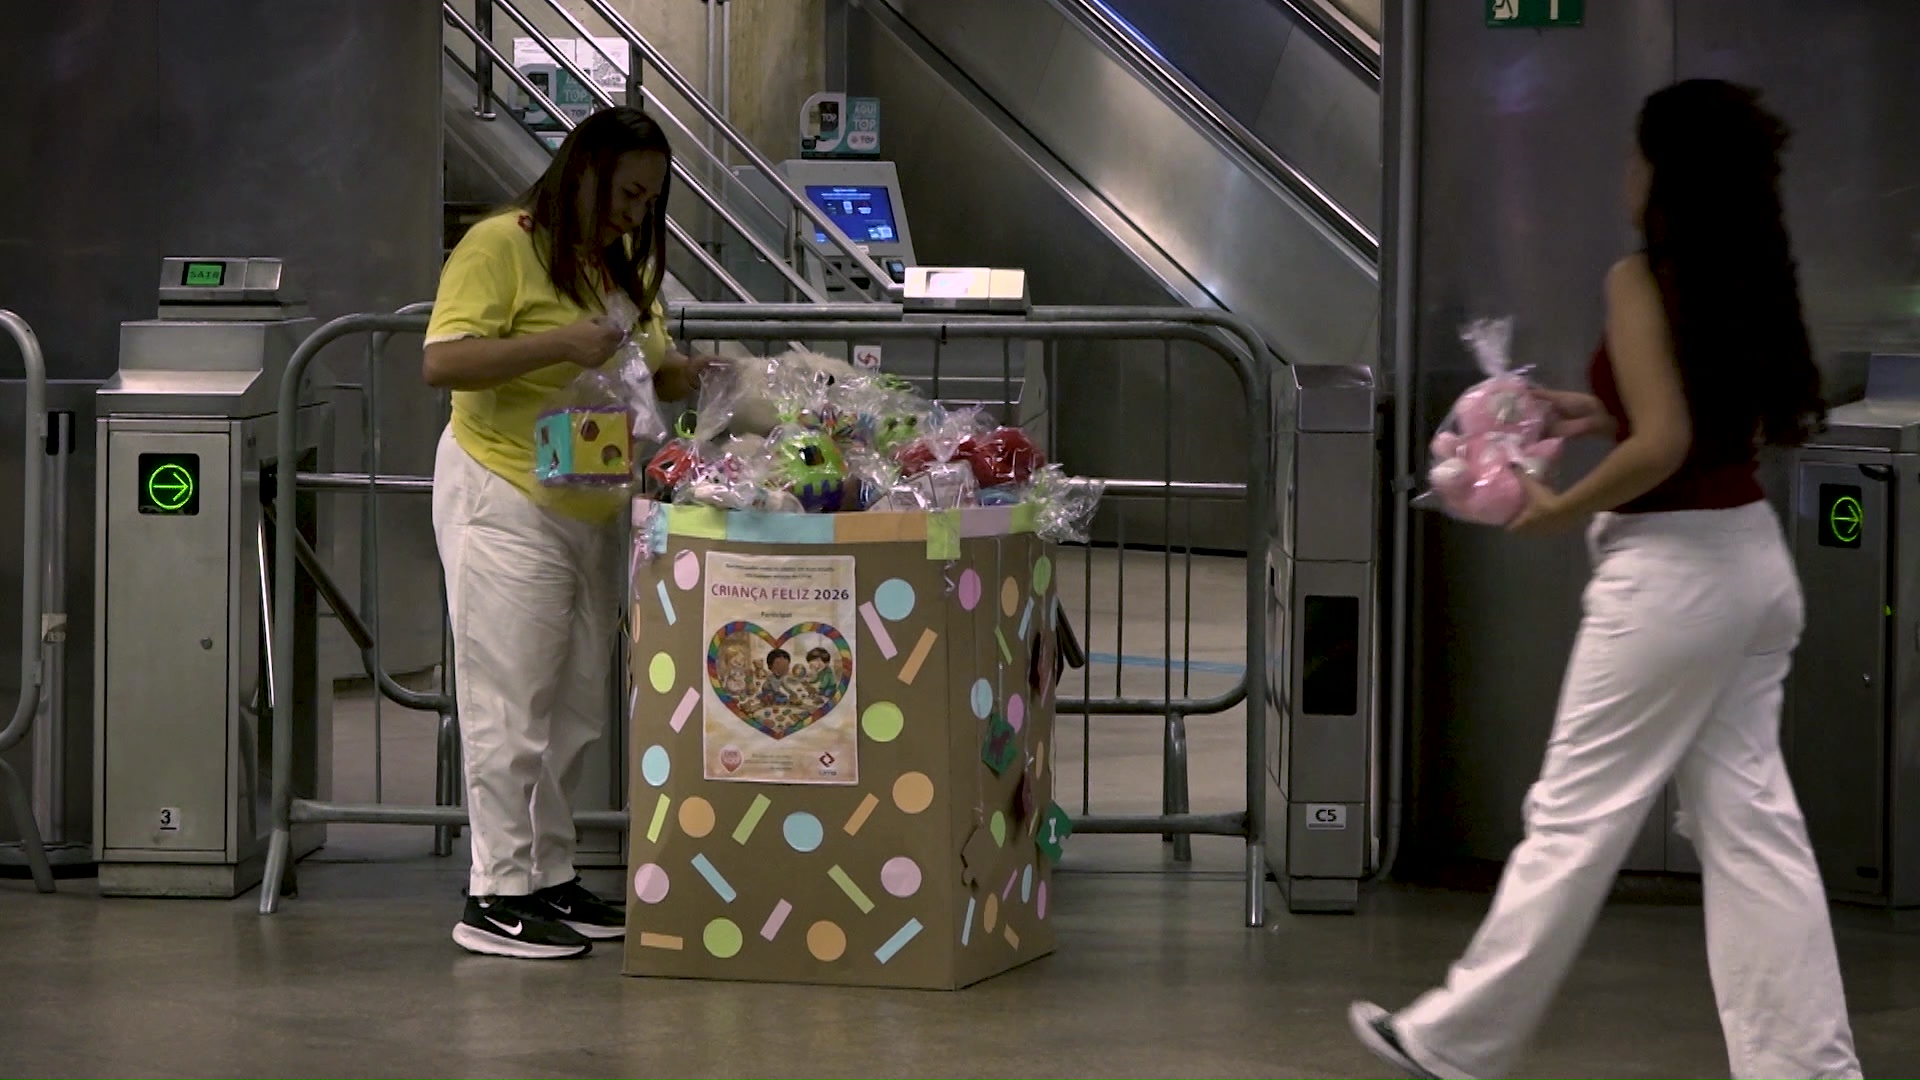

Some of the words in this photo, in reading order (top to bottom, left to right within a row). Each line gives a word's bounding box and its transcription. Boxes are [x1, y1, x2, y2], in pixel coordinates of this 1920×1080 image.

[853, 118, 877, 130] TOP
[711, 583, 768, 601] CRIANÇA
[771, 588, 810, 600] FELIZ
[814, 589, 850, 601] 2026
[160, 809, 171, 825] 3
[1315, 809, 1337, 822] C5
